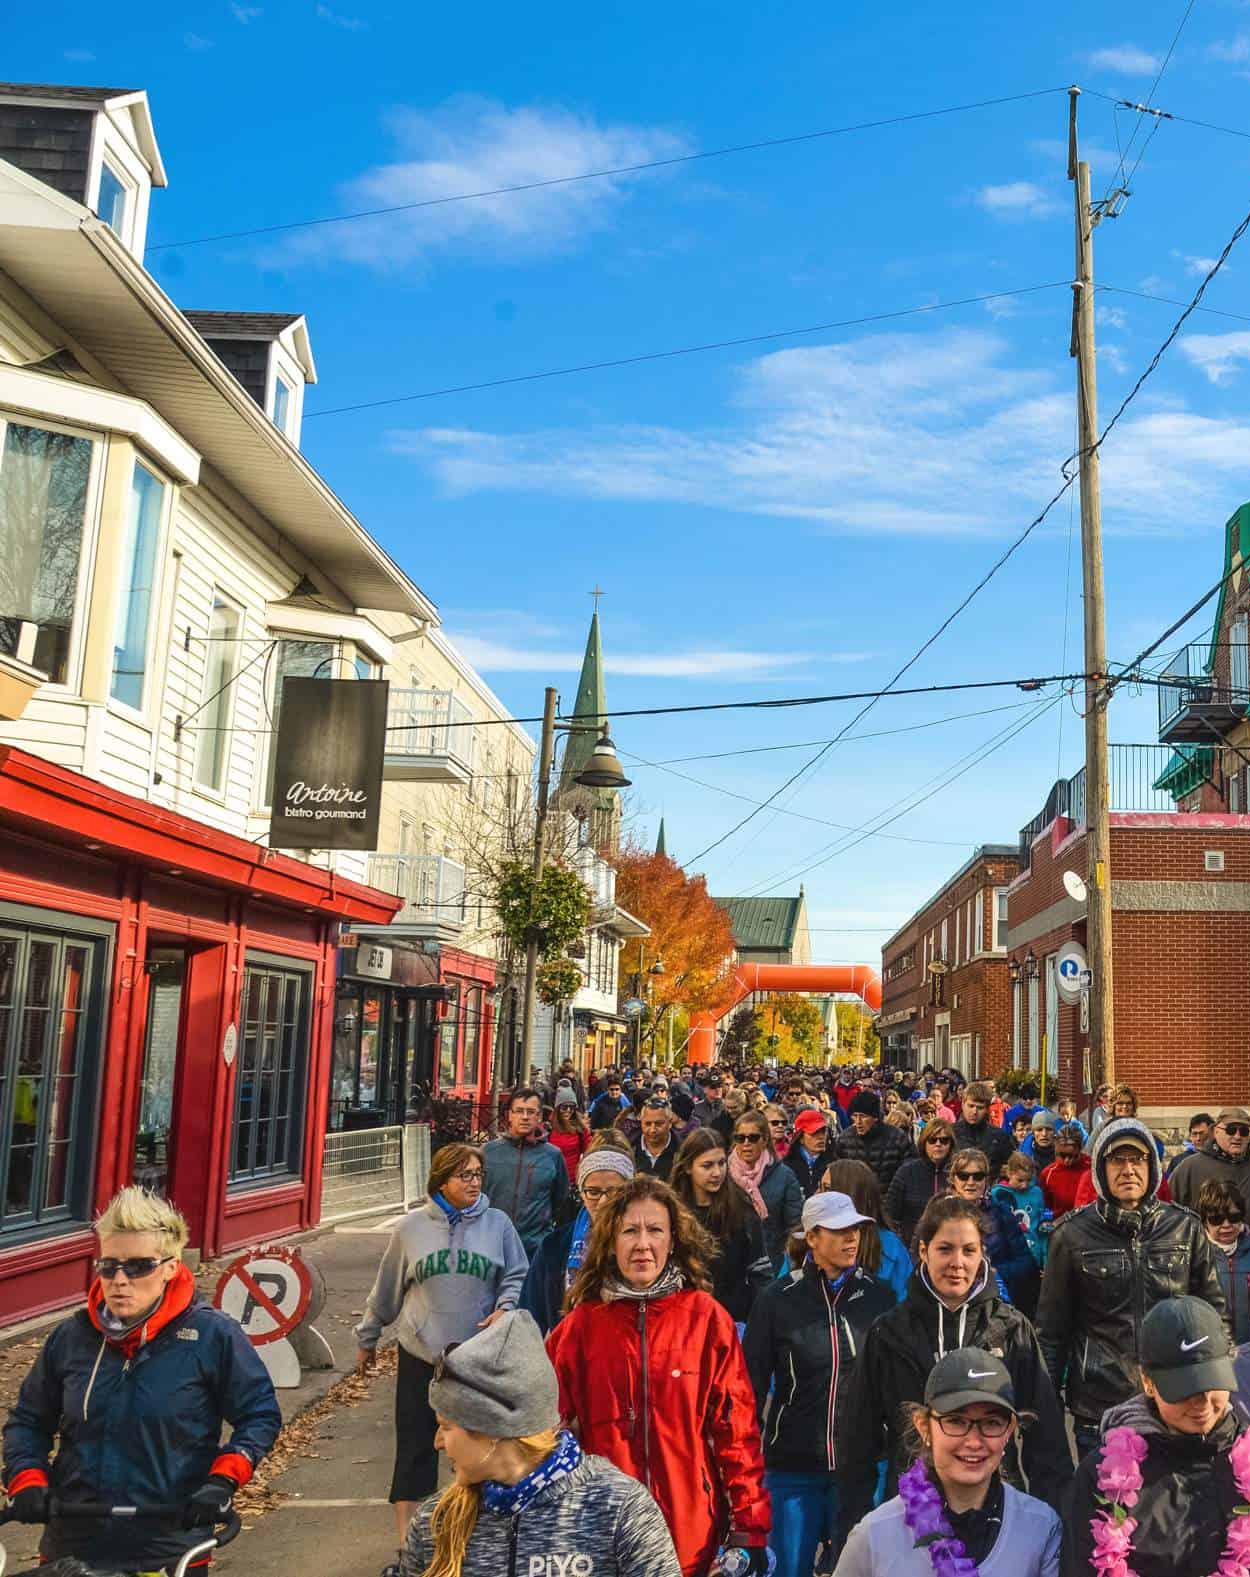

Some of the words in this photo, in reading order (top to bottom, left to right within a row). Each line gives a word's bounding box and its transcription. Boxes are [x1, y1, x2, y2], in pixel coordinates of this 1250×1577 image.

[286, 781, 368, 805] Antoine
[284, 806, 314, 818] bistro
[315, 808, 367, 820] gourmand
[415, 1250, 451, 1286] OAK
[456, 1250, 493, 1281] BAY
